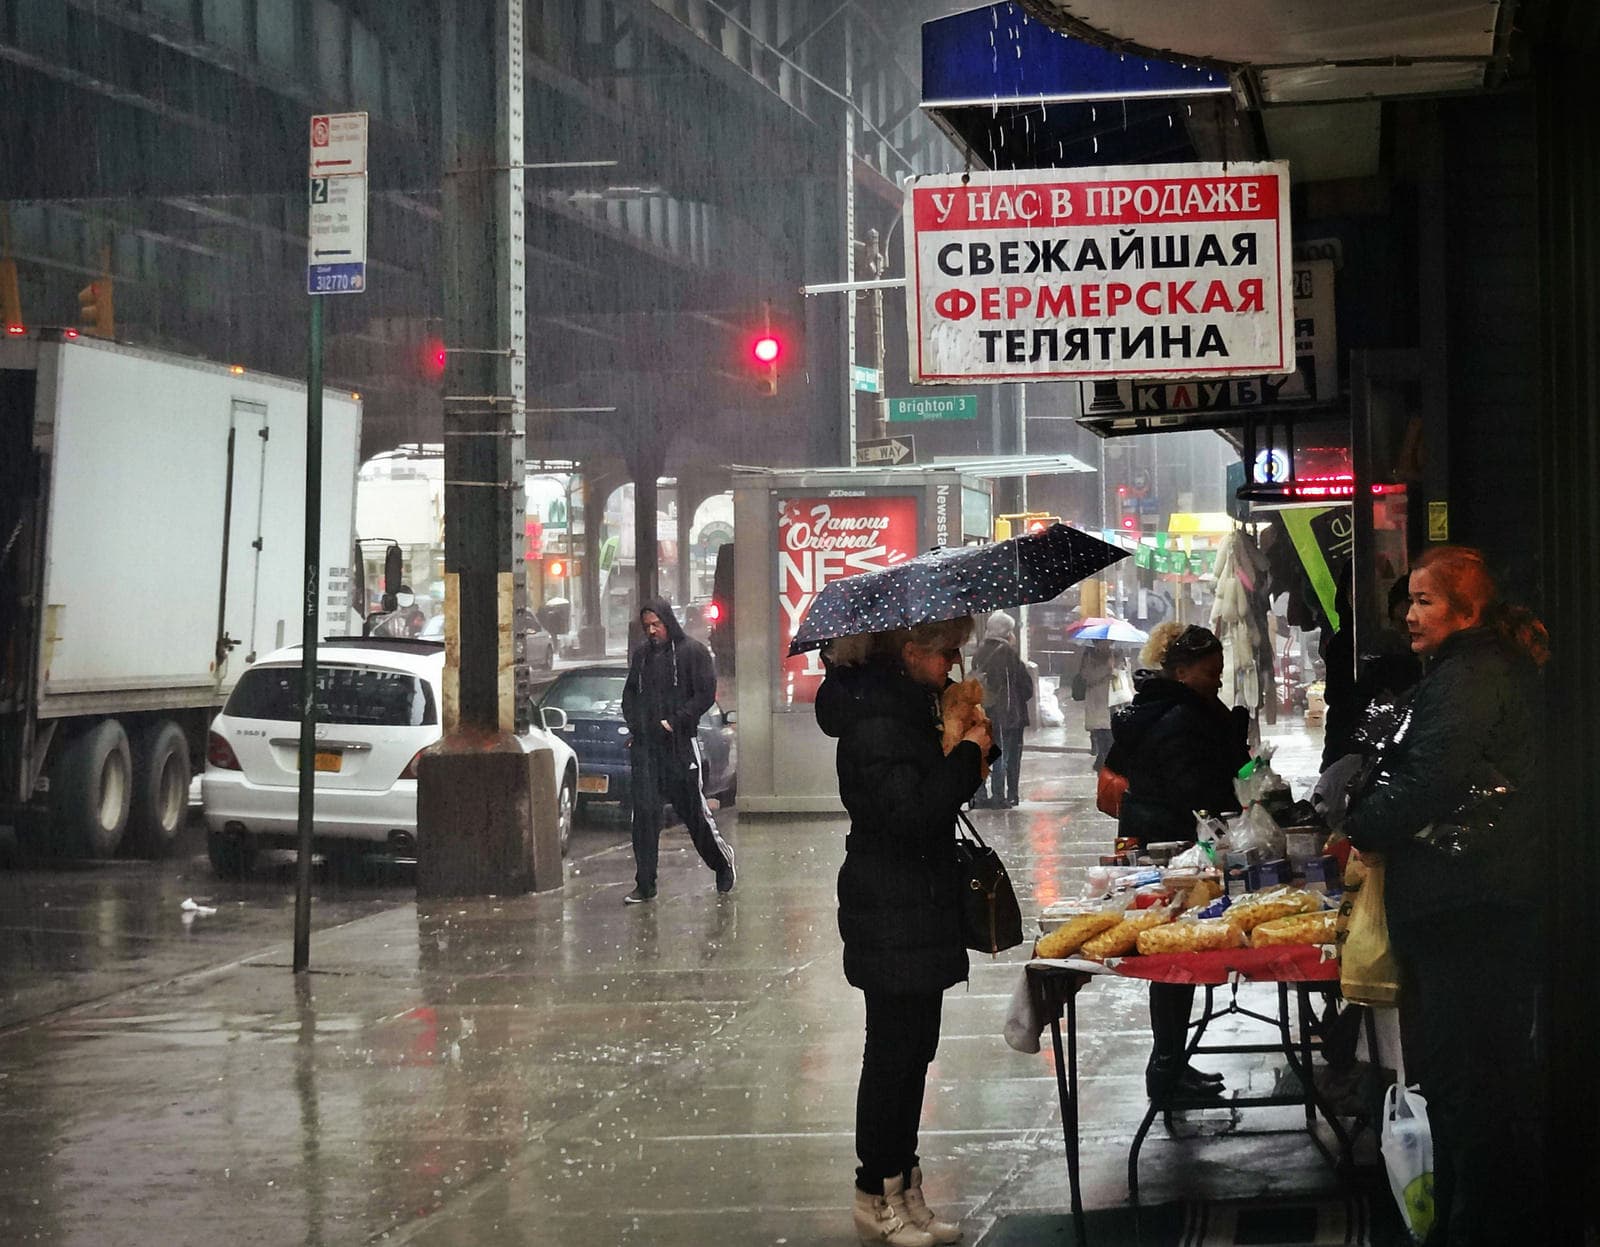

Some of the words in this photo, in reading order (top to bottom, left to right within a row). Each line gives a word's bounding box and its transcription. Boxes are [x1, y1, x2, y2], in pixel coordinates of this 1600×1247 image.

[314, 179, 325, 202] 2
[931, 193, 954, 224] У
[967, 190, 1038, 222] НАС
[1051, 188, 1073, 219] В
[1086, 182, 1261, 217] ПРОДАЖЕ
[937, 228, 1258, 276] СВЕЖАЙШАЯ
[935, 278, 1264, 320] ФЕРМЕРСКАЯ
[979, 324, 1230, 364] ТЕЛЯТИНА
[899, 399, 954, 416] Brighton
[959, 399, 966, 411] 3
[857, 448, 870, 461] NE
[880, 446, 902, 460] WAY
[810, 504, 890, 536] Famous
[936, 485, 950, 546] Newssta
[786, 522, 880, 552] Original
